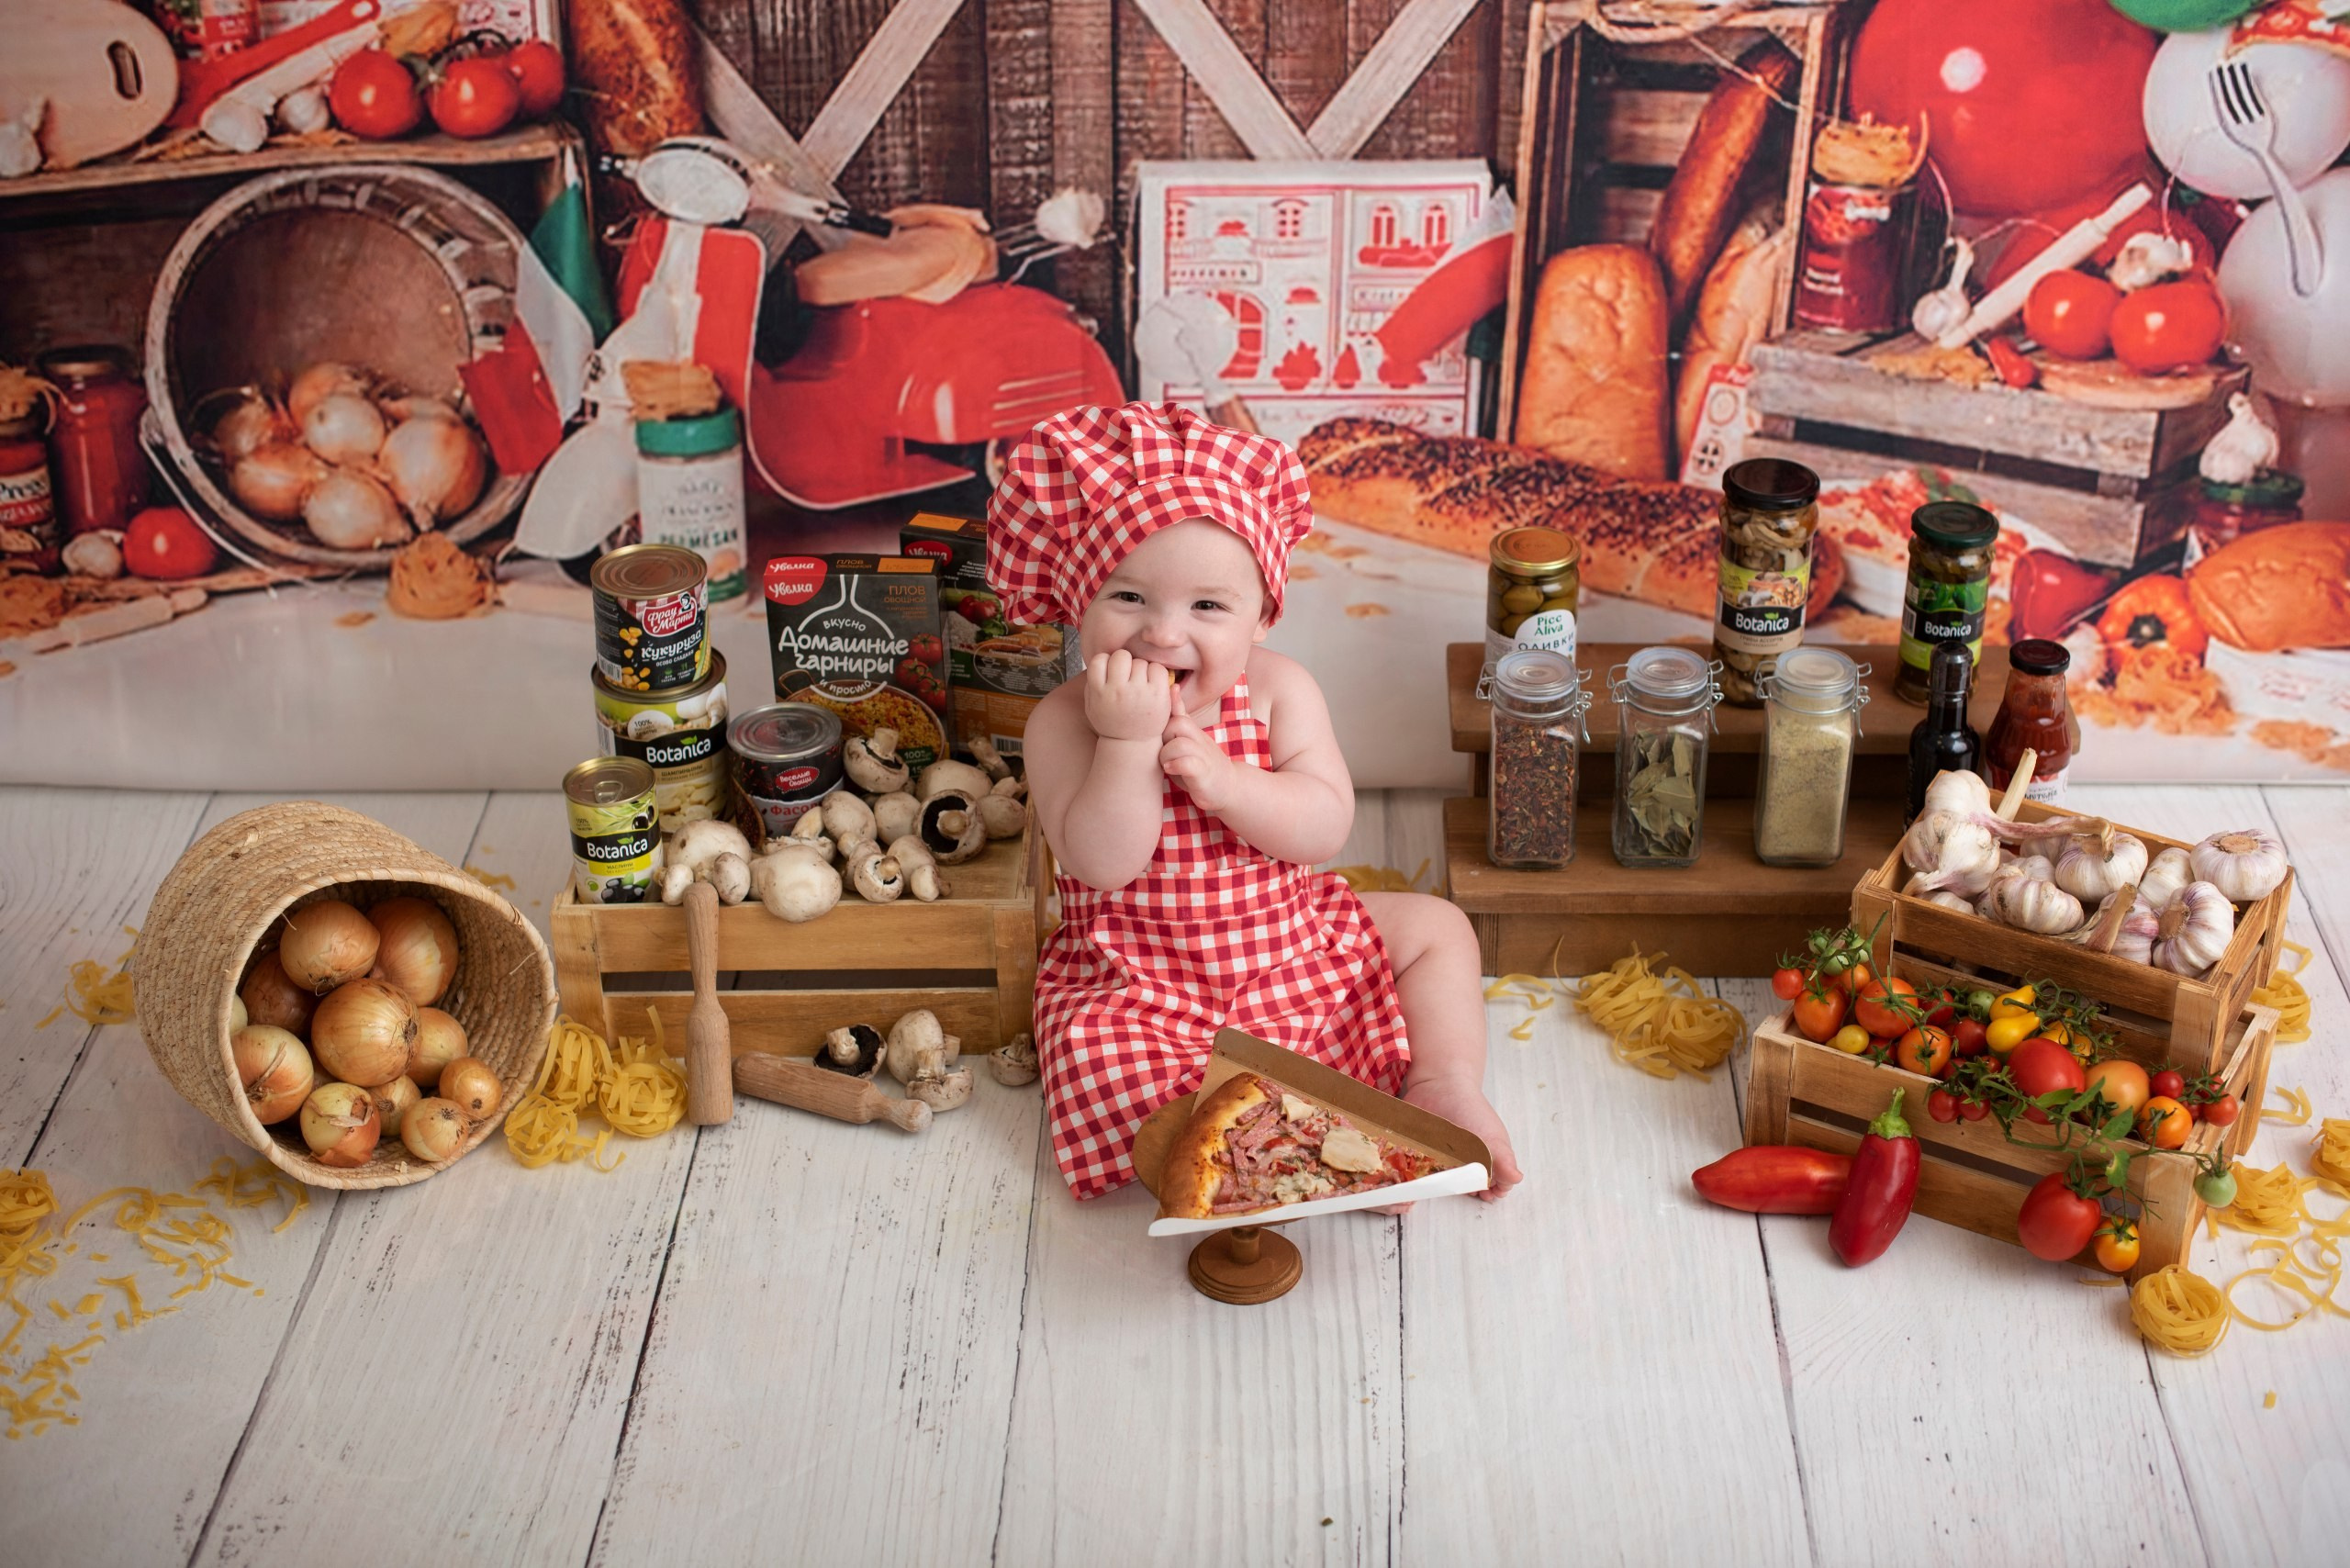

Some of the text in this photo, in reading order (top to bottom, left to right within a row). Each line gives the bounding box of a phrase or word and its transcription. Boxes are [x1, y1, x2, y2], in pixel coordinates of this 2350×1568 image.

[889, 585, 926, 596] ПЛОВ
[647, 607, 678, 626] Фрау
[653, 612, 694, 633] Марта
[1735, 612, 1789, 633] Botanica
[1924, 621, 1972, 638] Botanica
[641, 629, 702, 660] Кукуруза
[778, 625, 910, 658] Домашние
[1518, 633, 1574, 652] ОЛИВКИ
[794, 652, 894, 679] гарниры
[645, 738, 711, 764] Botanica
[587, 838, 648, 859] Botanica
